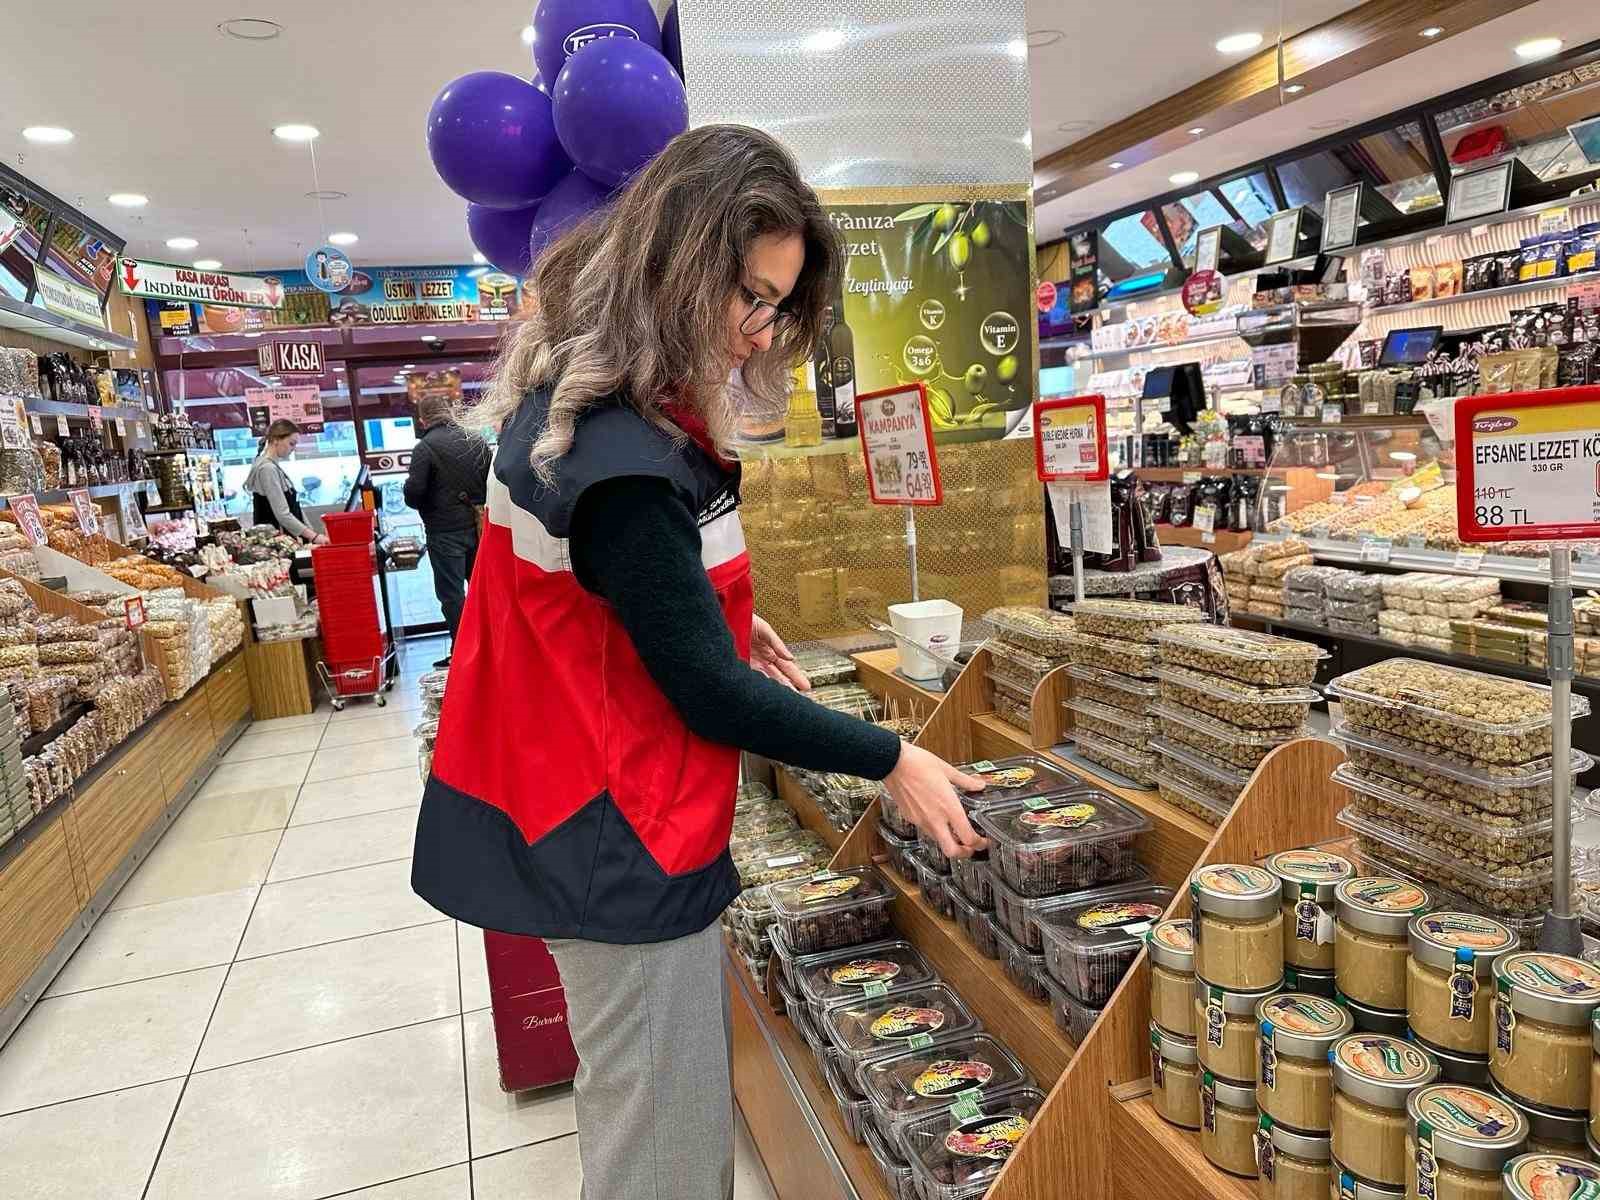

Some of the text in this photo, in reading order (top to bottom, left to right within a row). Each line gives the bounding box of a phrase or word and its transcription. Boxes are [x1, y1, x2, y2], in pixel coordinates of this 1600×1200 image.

[176, 270, 230, 288] KASA ARKASI
[848, 276, 914, 296] Zeytinyağı
[213, 288, 264, 305] ÜRÜNLER
[385, 280, 416, 298] ÜSTÜN
[421, 282, 453, 298] LEZZET
[372, 302, 407, 322] ÖDÜLLÜ
[929, 315, 937, 325] K
[984, 324, 1016, 335] Vitamin
[996, 334, 1006, 348] E
[279, 343, 320, 370] KASA
[907, 345, 934, 356] Omega
[868, 415, 917, 434] KAMPANYA
[906, 451, 919, 470] 79
[1475, 443, 1527, 464] EFSANE
[1530, 440, 1579, 461] LEZZET
[1532, 463, 1563, 472] 330 GR
[906, 473, 923, 498] 64
[1475, 486, 1511, 500] 110 TL
[1475, 505, 1535, 526] 88 TL
[522, 1012, 564, 1029] Burada
